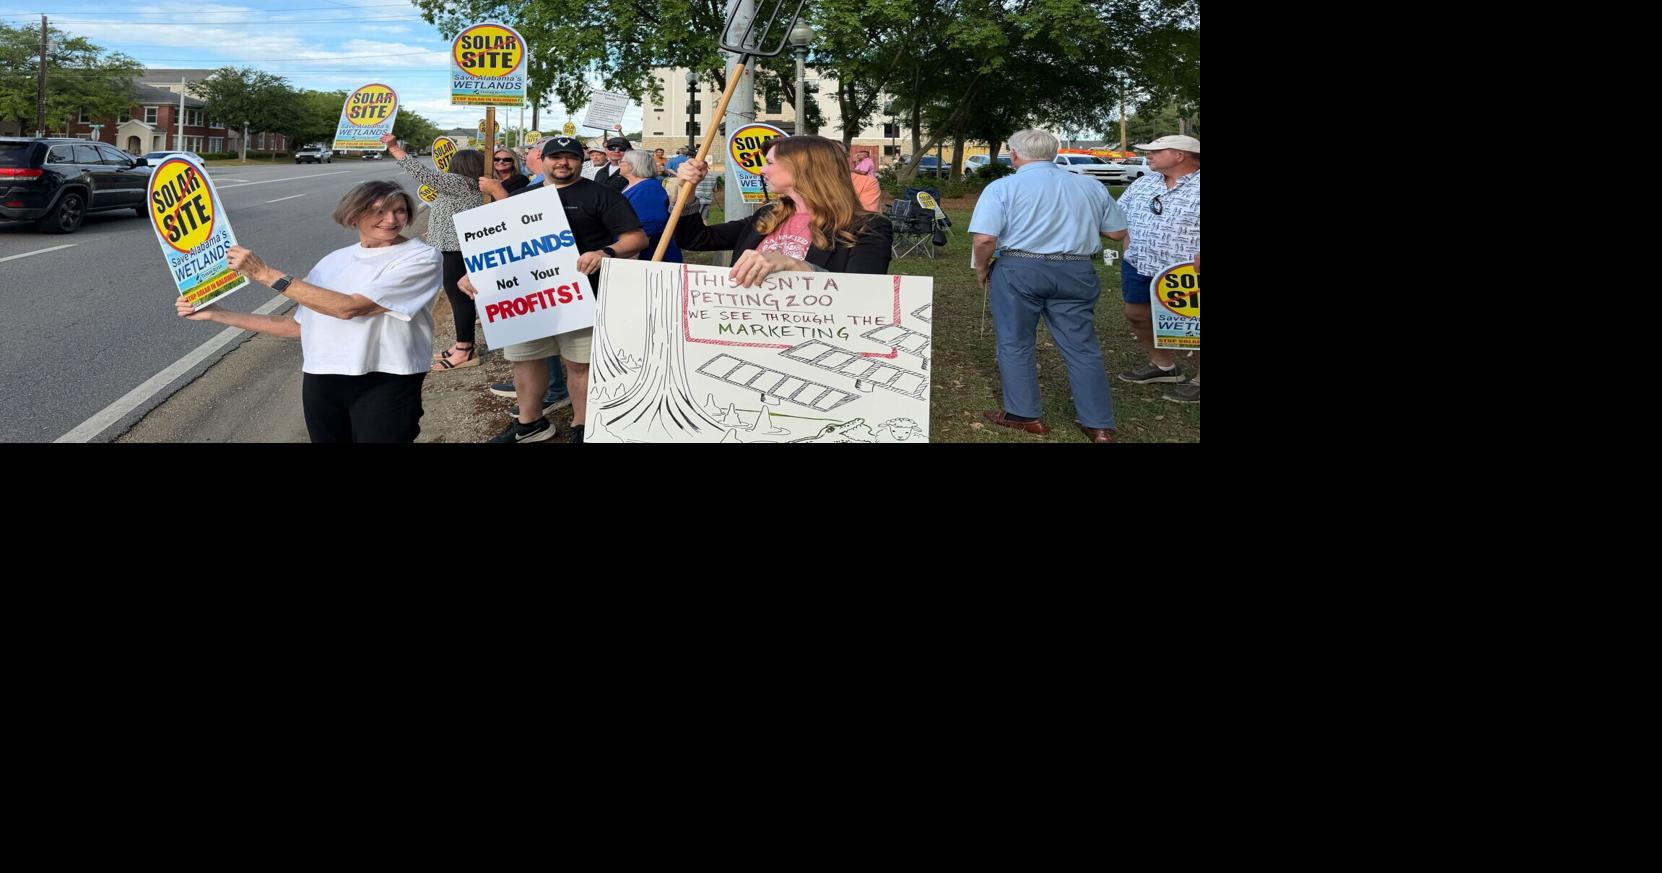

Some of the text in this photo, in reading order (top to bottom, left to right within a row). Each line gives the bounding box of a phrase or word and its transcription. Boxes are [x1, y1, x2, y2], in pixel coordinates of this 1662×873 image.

[462, 35, 516, 50] SOLAR
[462, 52, 513, 68] SITE
[454, 81, 522, 90] WETLANDS
[478, 74, 522, 82] Alabama's
[353, 92, 393, 104] SOLAR
[351, 106, 388, 118] SITE
[739, 152, 763, 167] SI
[152, 166, 201, 214] SOLAR
[162, 194, 211, 243] SITE
[464, 212, 543, 242] Protect Our
[171, 230, 228, 268] Save Alabama's
[464, 230, 575, 273] WETLANDS
[174, 240, 231, 282] WETLANDS
[496, 266, 560, 291] Not Your
[758, 276, 815, 291] SN'T
[824, 278, 839, 291] A
[485, 281, 583, 324] PROFITS!
[690, 290, 833, 311] PETTING ZOO
[688, 310, 886, 326] WE SEE THROUGH THE
[718, 323, 850, 340] MARKETING
